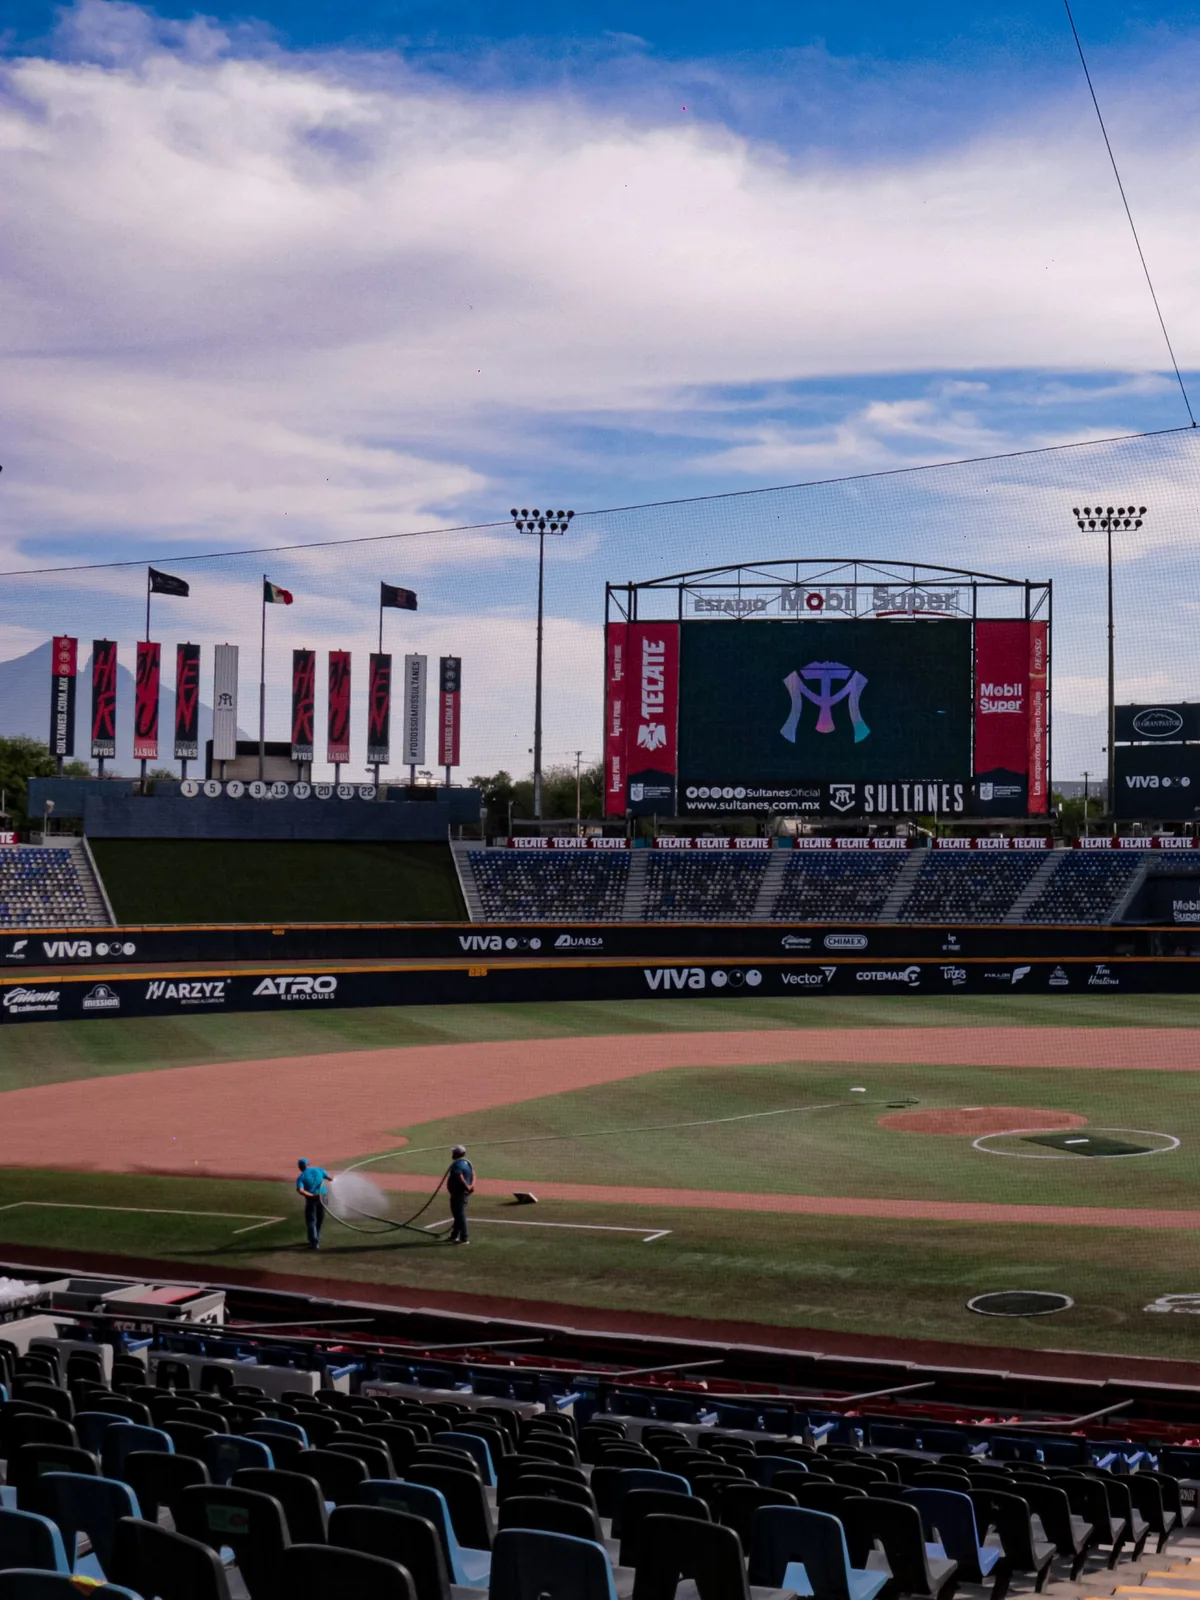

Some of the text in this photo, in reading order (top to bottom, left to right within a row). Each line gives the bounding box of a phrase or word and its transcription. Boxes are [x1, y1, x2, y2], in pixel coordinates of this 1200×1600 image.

[694, 587, 954, 616] ESTADIO Mobil Super
[1034, 639, 1042, 670] DENSO
[641, 636, 665, 720] TECATE
[980, 683, 1022, 696] Mobil
[980, 698, 1022, 711] Super
[57, 676, 69, 754] SULTANES.COM.MX
[274, 784, 286, 795] 13
[296, 784, 308, 795] 17
[318, 785, 330, 796] 20
[339, 785, 351, 796] 21
[361, 786, 373, 797] 22
[864, 784, 964, 812] SULTANES
[686, 801, 820, 811] www.sultanes.com.mx
[512, 837, 626, 848] TECATE TECATE TECATE
[656, 837, 769, 848] TECATE TECATE TECATE
[798, 837, 907, 848] TECATE TECATE TECATE
[936, 837, 1047, 848] TECATE TECATE TECATE
[1078, 836, 1193, 848] TECATE TECATE TECATE
[1172, 911, 1200, 922] Super
[828, 937, 863, 945] CHIMEX
[1094, 964, 1110, 975] Tim
[781, 972, 823, 985] Vector
[1088, 975, 1120, 986] Hortons
[252, 975, 338, 996] ATRO
[3, 987, 60, 1007] Caliente
[281, 993, 335, 1001] REMOLQUES
